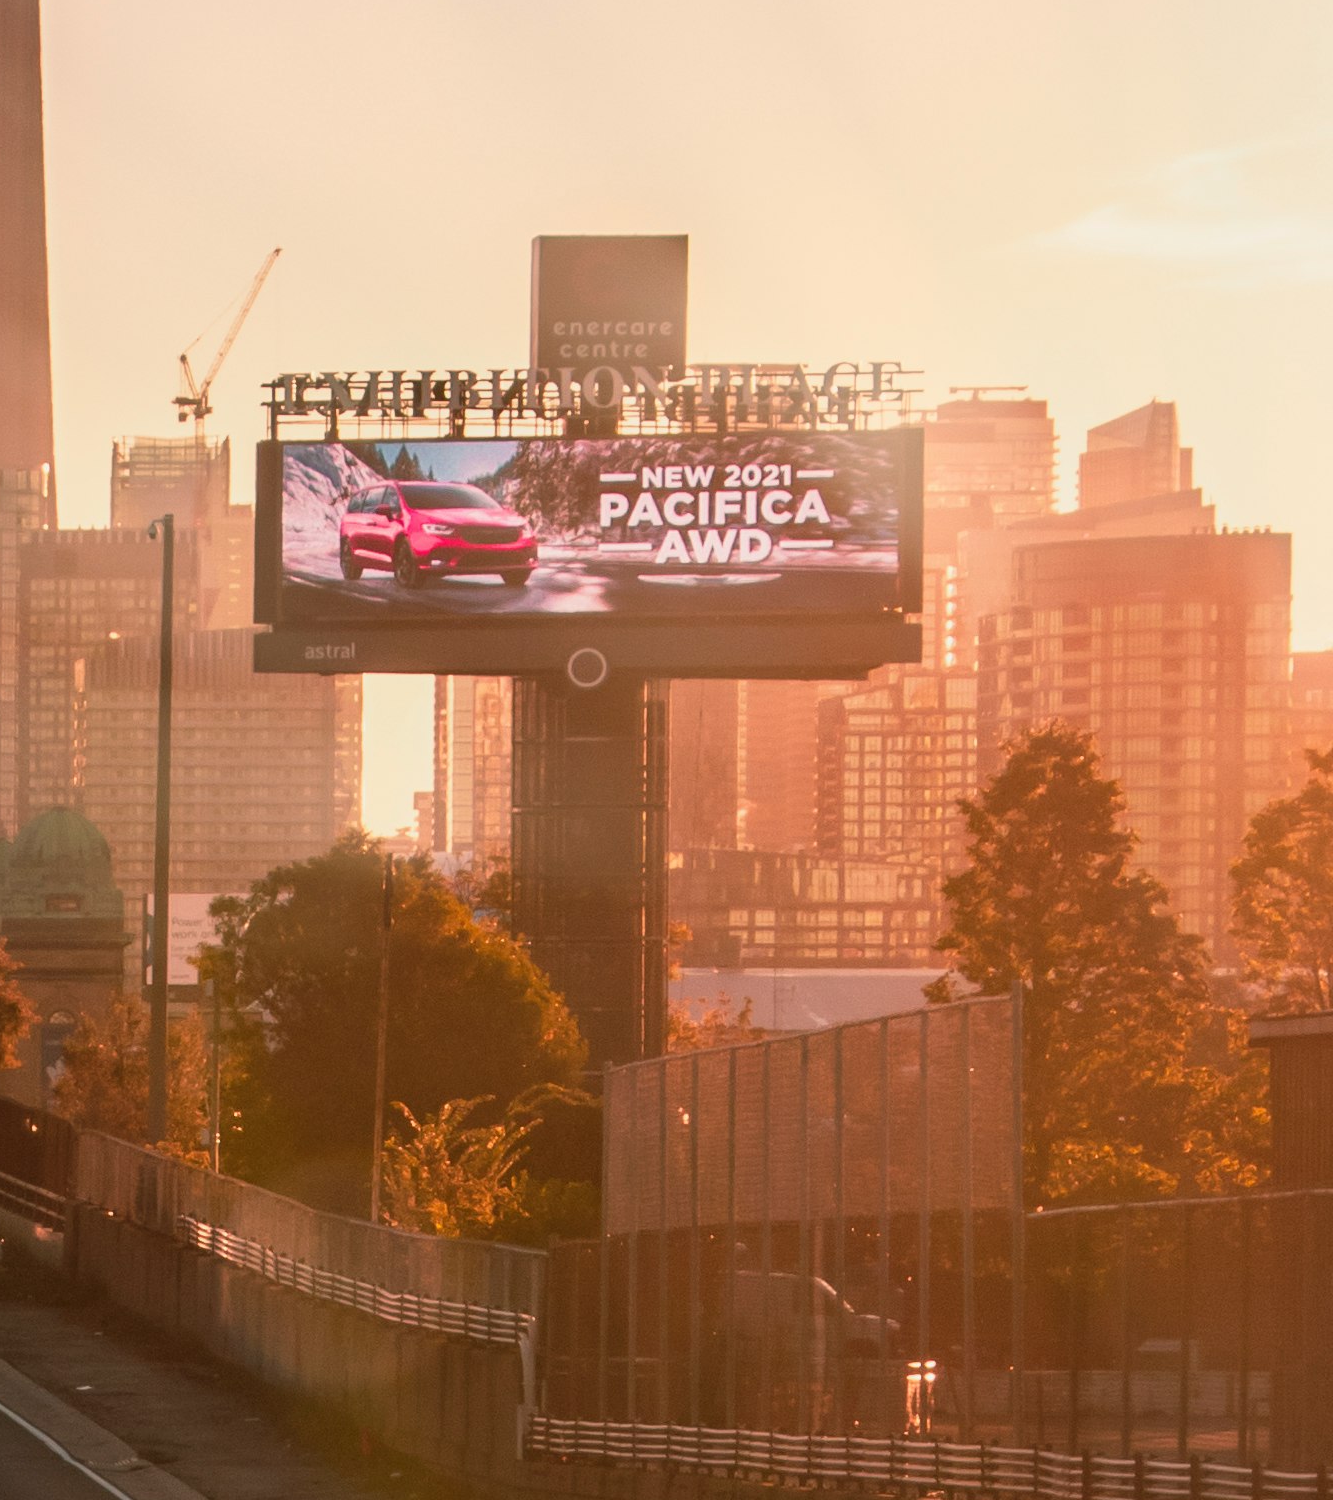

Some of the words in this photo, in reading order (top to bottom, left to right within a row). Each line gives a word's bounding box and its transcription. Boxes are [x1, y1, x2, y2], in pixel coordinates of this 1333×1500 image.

[552, 320, 674, 336] enercare
[559, 339, 649, 358] centre
[279, 364, 675, 415] EXHIBITION
[641, 465, 716, 489] NEW
[723, 463, 793, 488] 2021
[599, 488, 831, 527] PACIFICA
[654, 527, 773, 564] AWD
[304, 641, 356, 660] astral
